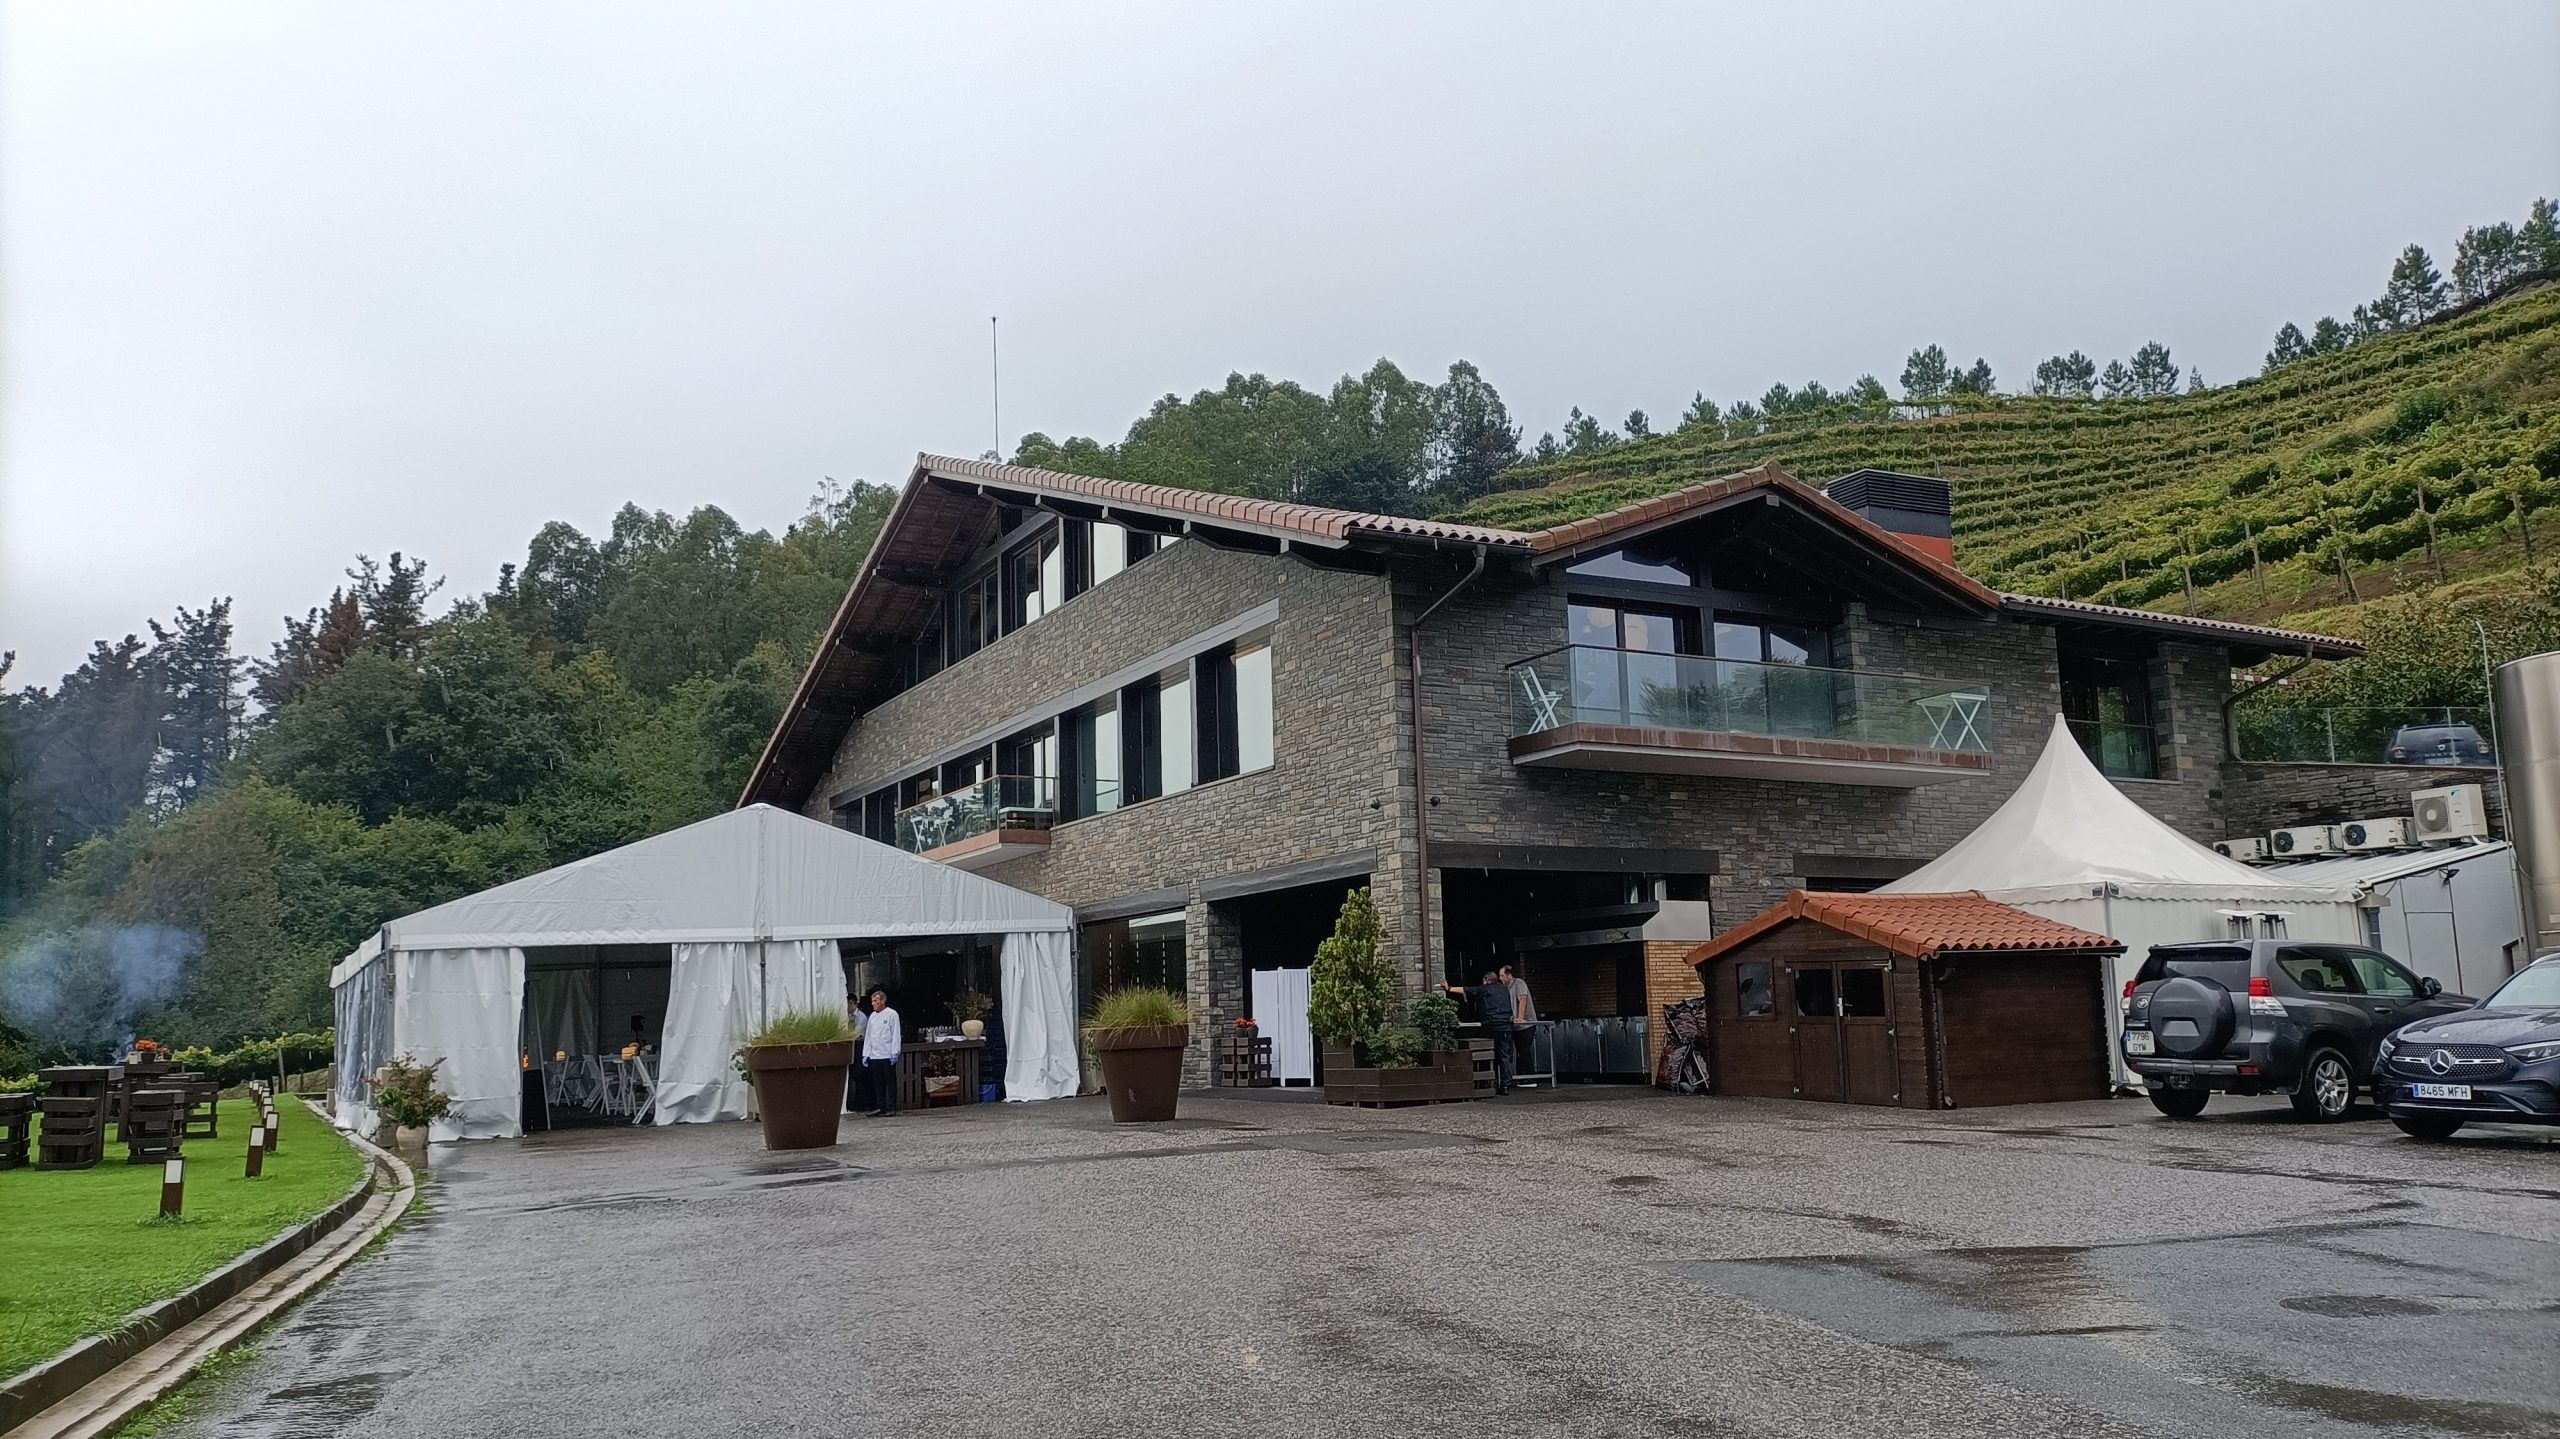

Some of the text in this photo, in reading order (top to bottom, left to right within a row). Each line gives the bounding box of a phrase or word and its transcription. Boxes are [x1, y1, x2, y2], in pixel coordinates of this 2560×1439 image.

[2131, 1031, 2150, 1041] 7796
[2420, 1085, 2468, 1098] 8465 MFH
